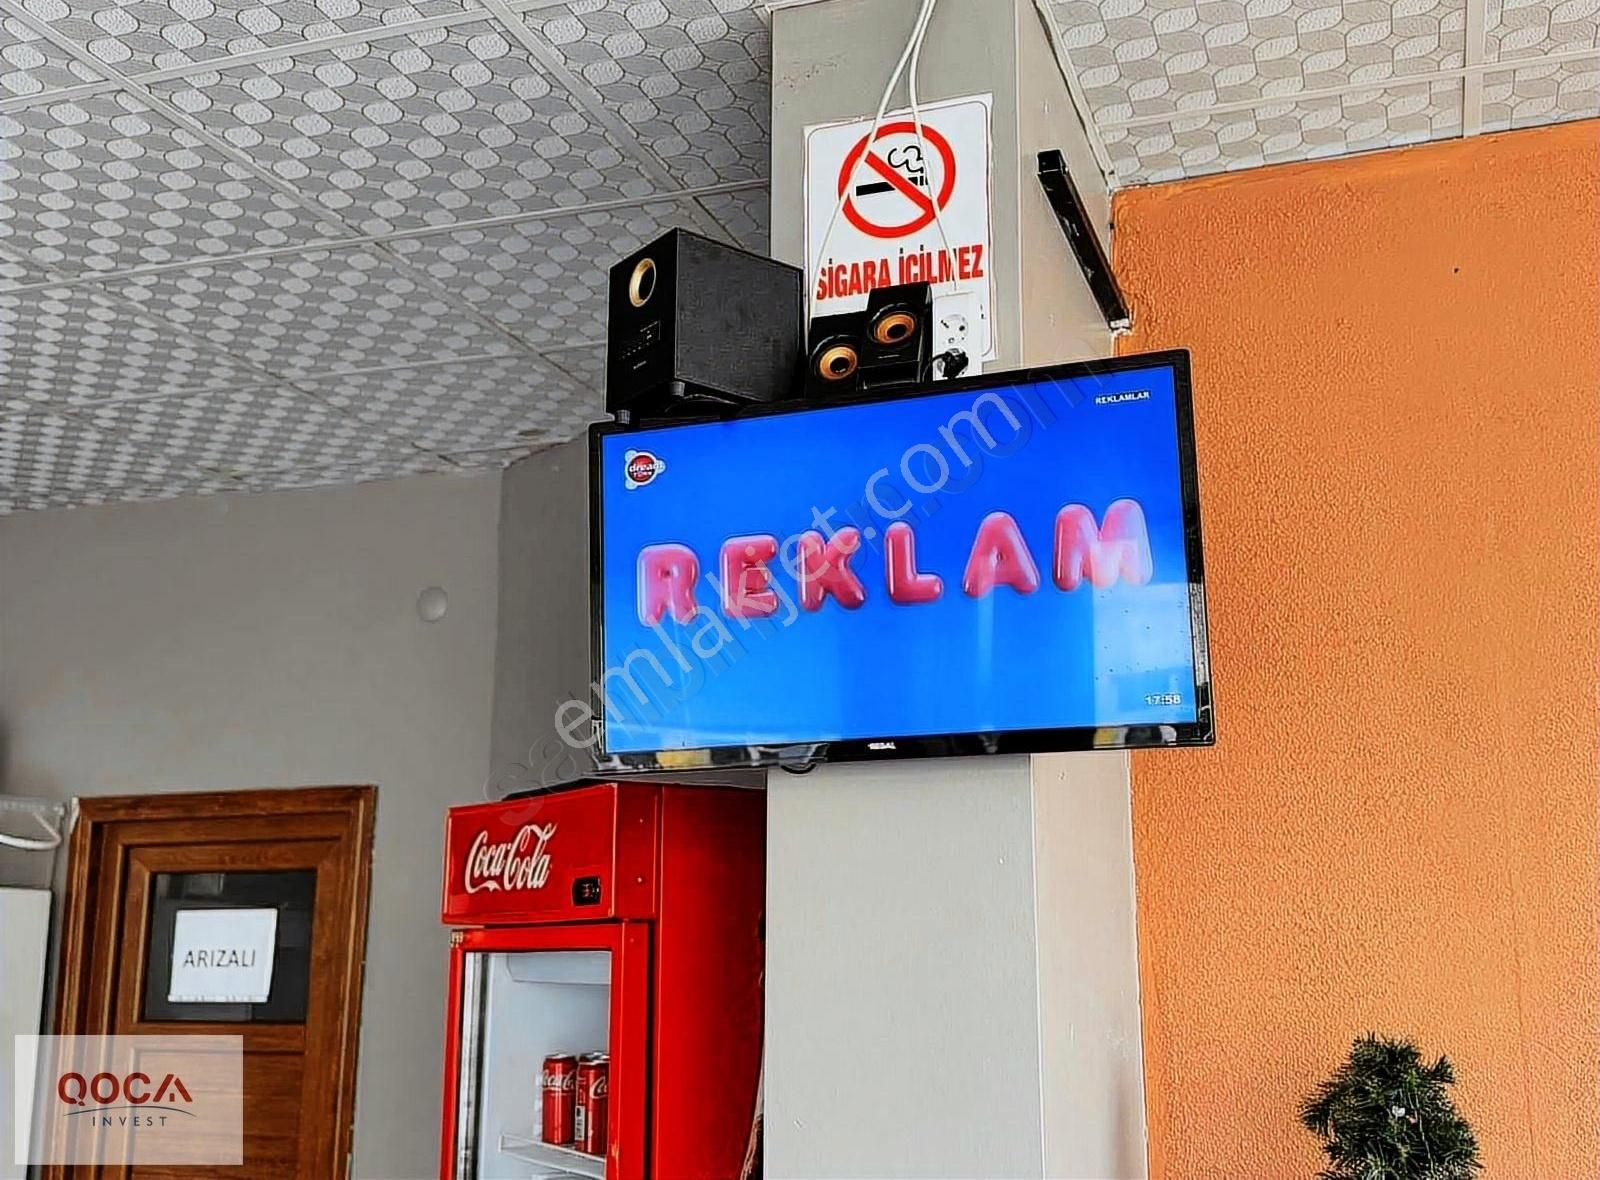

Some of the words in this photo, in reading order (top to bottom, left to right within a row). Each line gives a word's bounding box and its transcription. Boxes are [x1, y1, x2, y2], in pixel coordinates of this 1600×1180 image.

[1095, 390, 1150, 405] REKLAMLAR
[636, 498, 1153, 628] REKLAM
[1144, 694, 1182, 705] 17:58
[464, 822, 557, 894] Coca-Cola
[182, 949, 257, 968] ARIZALI
